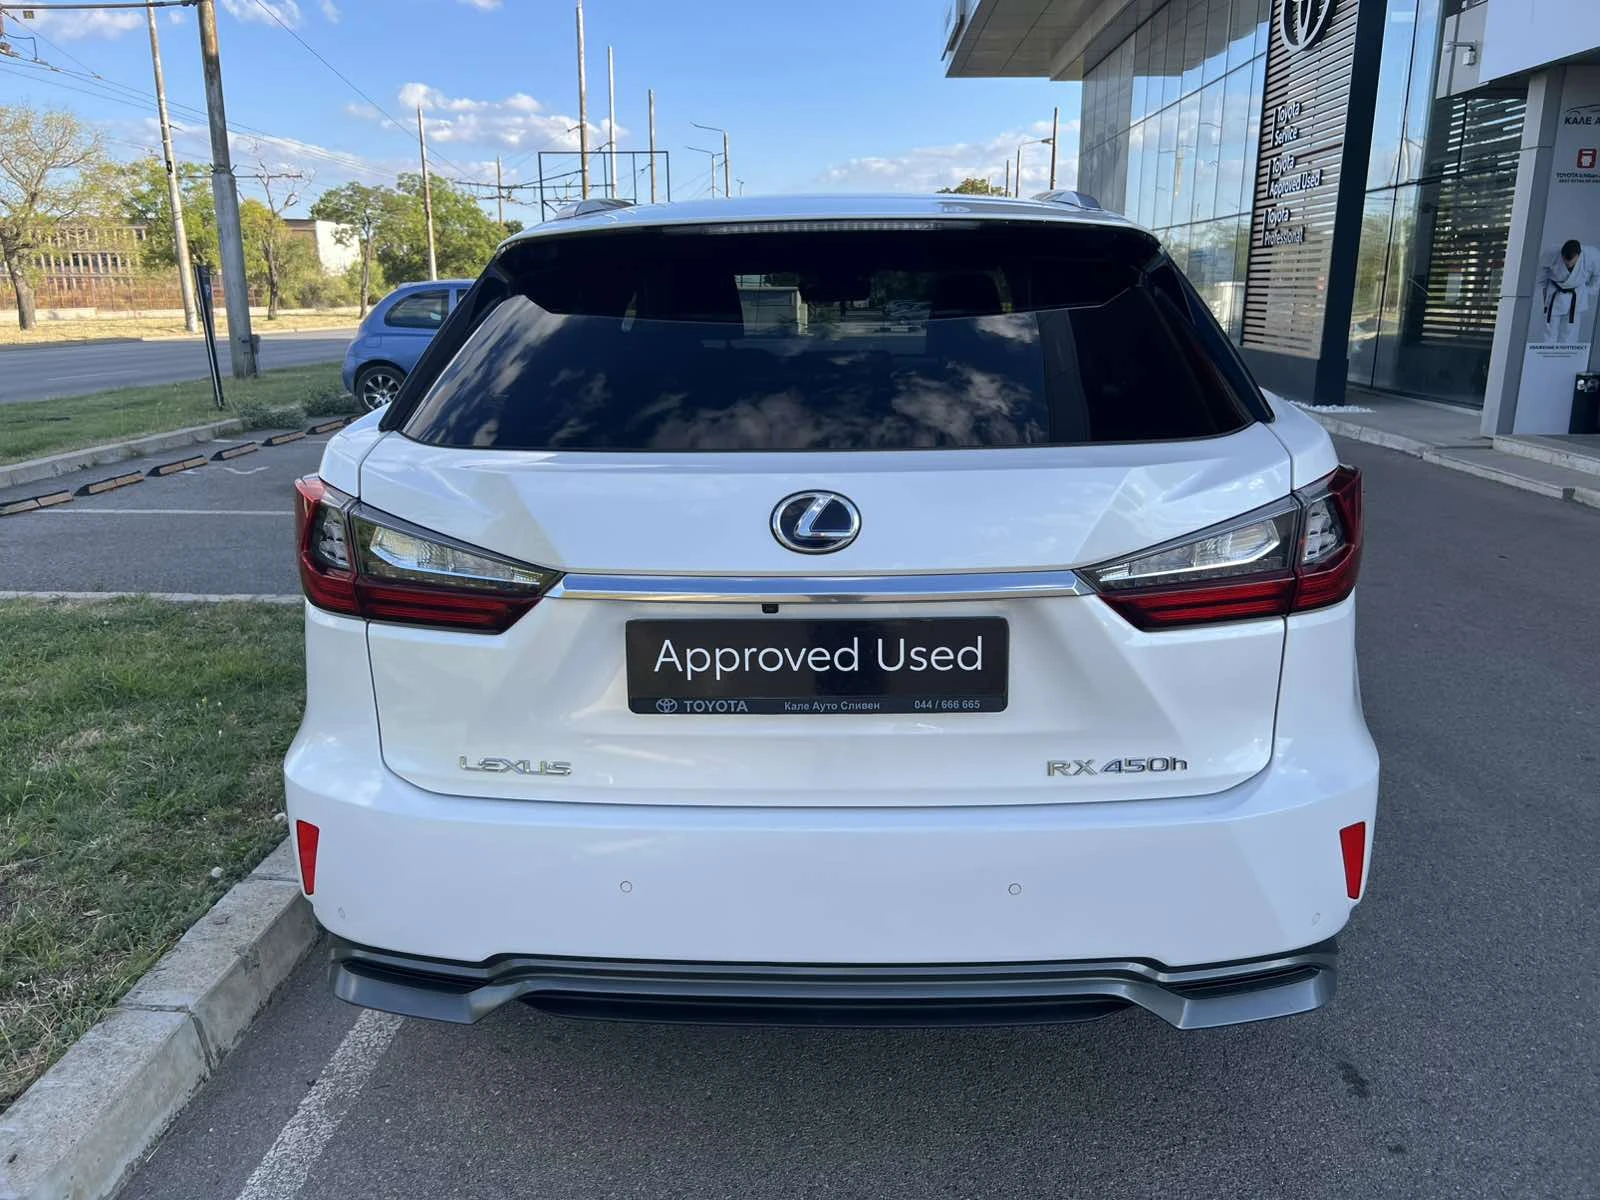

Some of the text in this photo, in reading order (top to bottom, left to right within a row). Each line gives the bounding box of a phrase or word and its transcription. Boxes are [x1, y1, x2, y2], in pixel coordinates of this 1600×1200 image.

[1277, 101, 1301, 124] Toyota
[1274, 126, 1298, 147] Service
[1272, 155, 1295, 177] Toyota
[1269, 168, 1321, 200] Approved Used
[1266, 208, 1289, 226] Toyota
[1263, 225, 1304, 247] Professional
[653, 635, 984, 681] Approved Used
[683, 700, 749, 713] TOYOTA
[784, 699, 881, 713] Кале Ауто Сливен
[914, 699, 933, 710] 044
[941, 699, 960, 710] 666
[962, 699, 981, 710] 665
[459, 755, 573, 776] LEXUS
[1046, 756, 1188, 777] RX 450h
